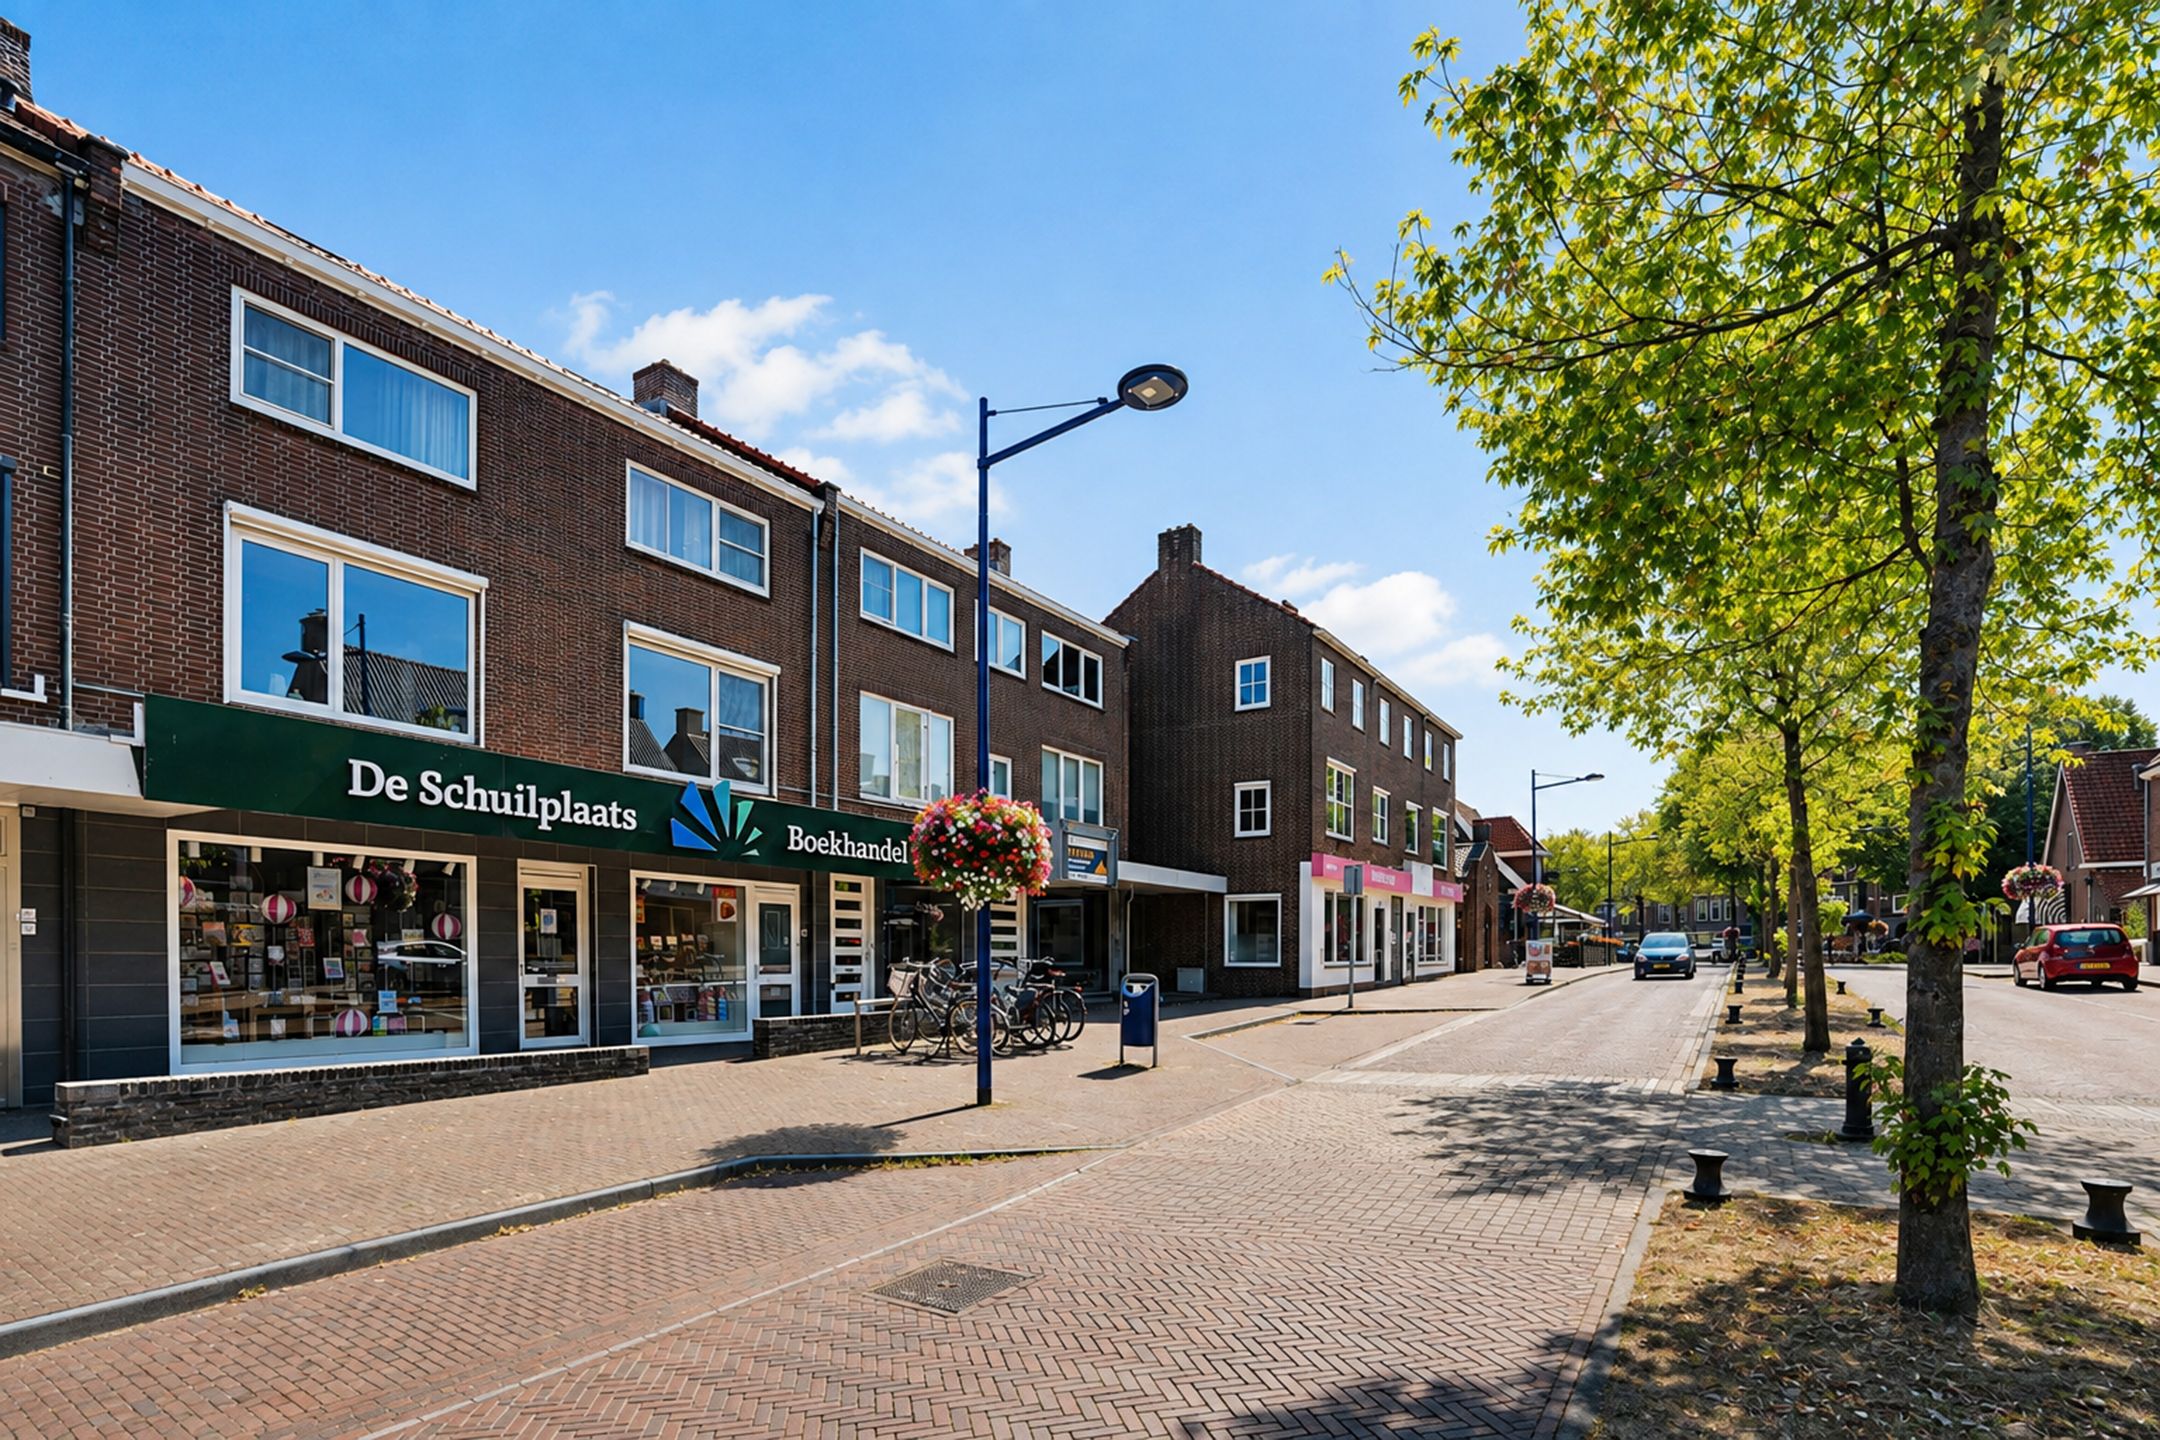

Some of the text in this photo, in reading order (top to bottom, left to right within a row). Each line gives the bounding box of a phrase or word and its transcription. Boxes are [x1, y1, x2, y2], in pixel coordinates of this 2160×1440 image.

[348, 758, 638, 831] De Schuilplaats
[787, 825, 908, 864] Boekhandel
